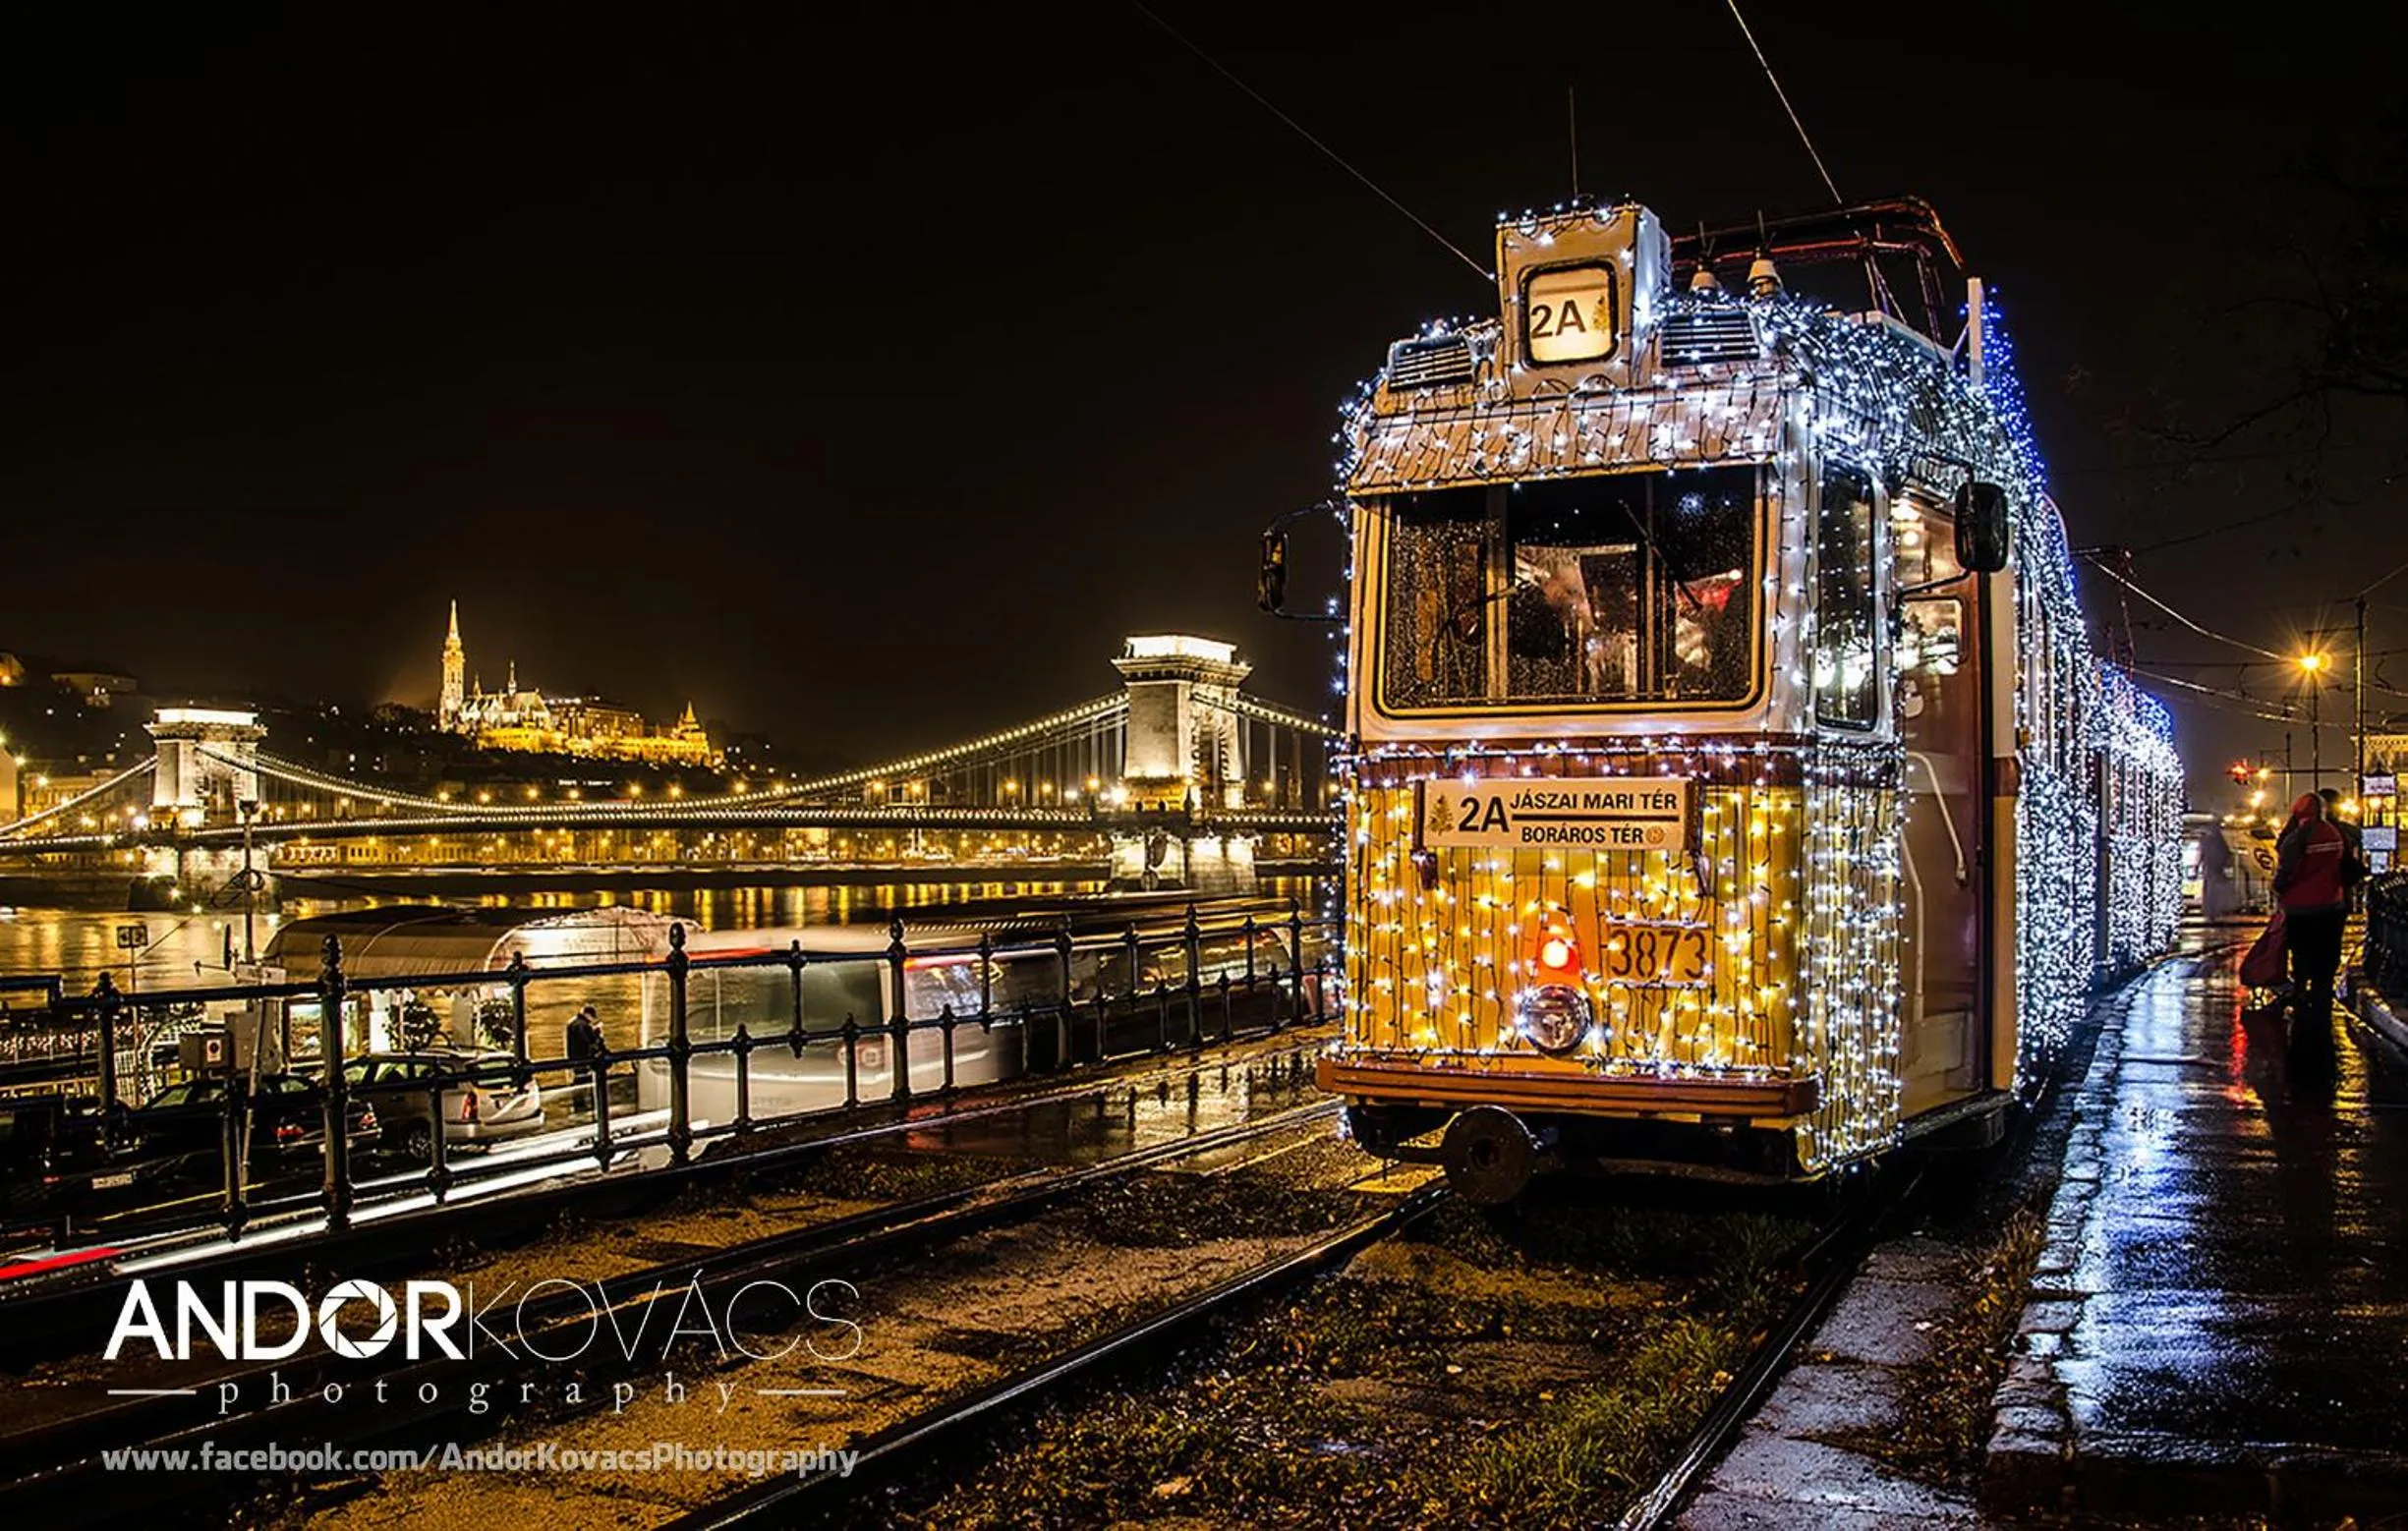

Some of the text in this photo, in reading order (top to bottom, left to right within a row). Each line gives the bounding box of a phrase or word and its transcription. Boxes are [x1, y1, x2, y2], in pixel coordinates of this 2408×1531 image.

[1530, 299, 1587, 339] 2A
[1458, 789, 1677, 833] 2A JÁSZAI MARI TÉR
[1521, 823, 1643, 844] BORÁROS TÉR
[1610, 929, 1707, 979] 3873
